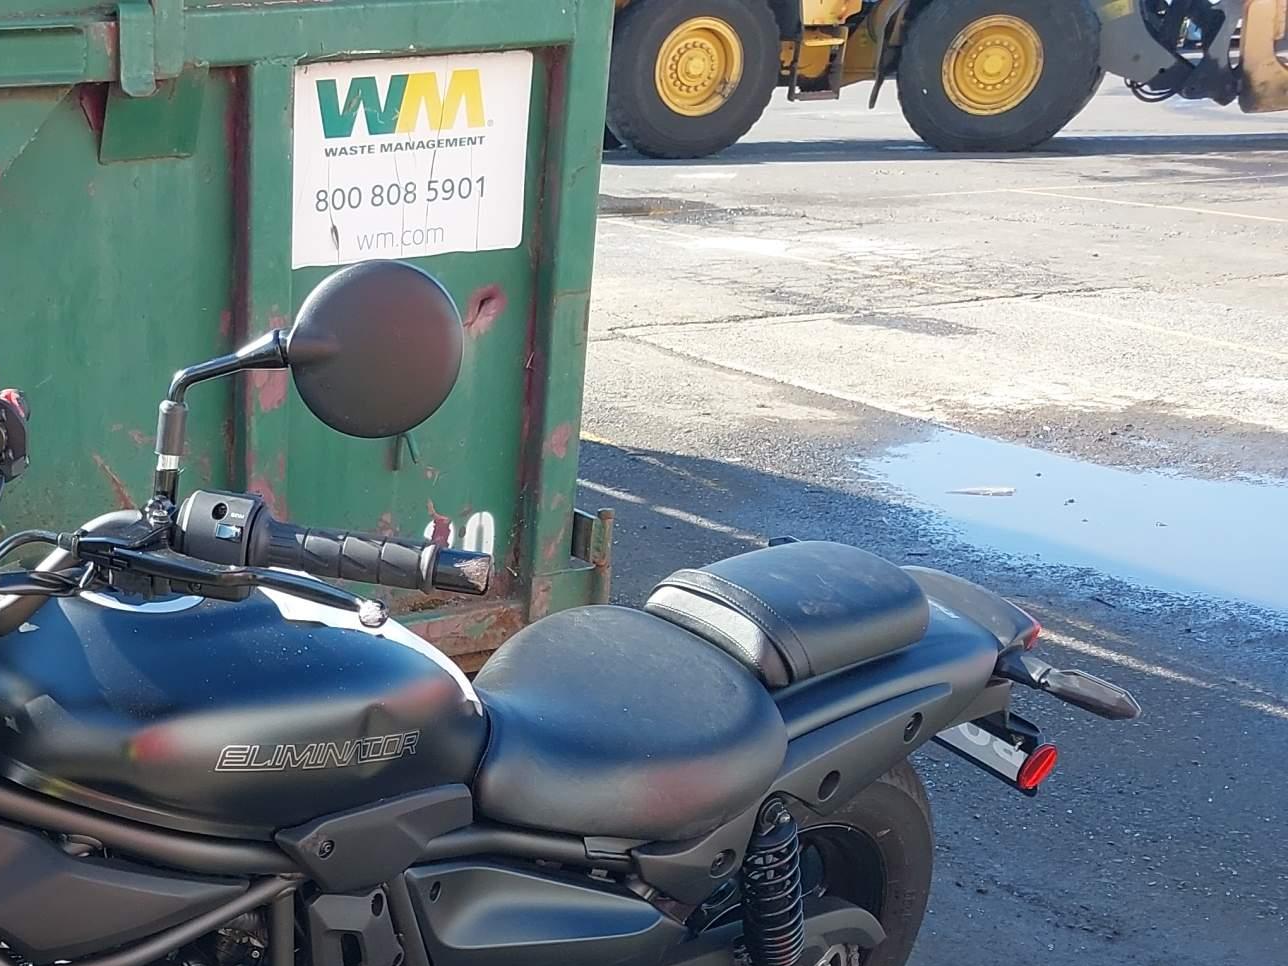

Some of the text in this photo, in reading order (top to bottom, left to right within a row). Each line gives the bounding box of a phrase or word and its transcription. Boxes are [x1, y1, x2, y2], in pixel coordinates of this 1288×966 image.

[316, 69, 485, 139] WM
[324, 135, 485, 157] WASTE MANAGEMENT
[315, 175, 485, 212] 800 808 5901
[357, 226, 444, 251] wm.com
[214, 730, 420, 771] ELIMINATOR
